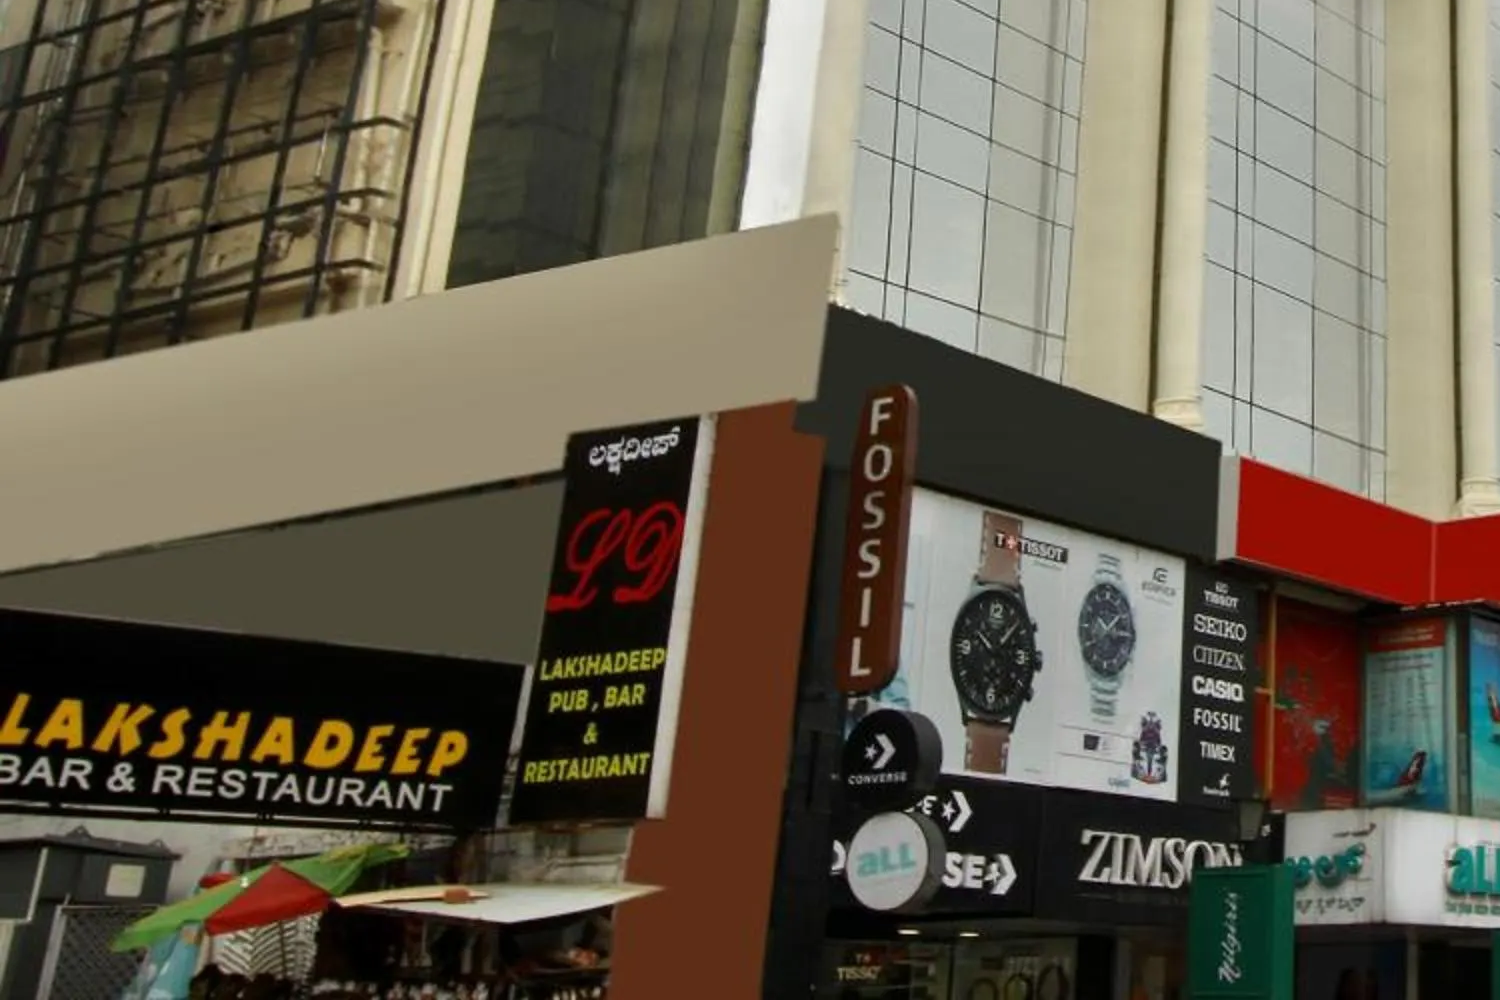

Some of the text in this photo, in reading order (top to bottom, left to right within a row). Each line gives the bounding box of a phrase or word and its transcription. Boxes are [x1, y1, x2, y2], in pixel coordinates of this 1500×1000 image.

[850, 397, 894, 677] FOSSIL
[1193, 613, 1247, 641] SEIKO
[540, 648, 667, 681] LAKSHADEEP
[1193, 645, 1244, 670] CITIZEN
[604, 683, 646, 709] BAR
[1192, 675, 1244, 701] CASIO
[1193, 708, 1242, 732] FOSSIL
[0, 692, 469, 777] LAKSHADEEP
[583, 722, 598, 745] &
[1200, 741, 1235, 764] TIMEX
[523, 752, 650, 784] RESTAURANT
[848, 771, 908, 785] CONVERSE
[0, 753, 453, 812] BAR & RESTAURANT
